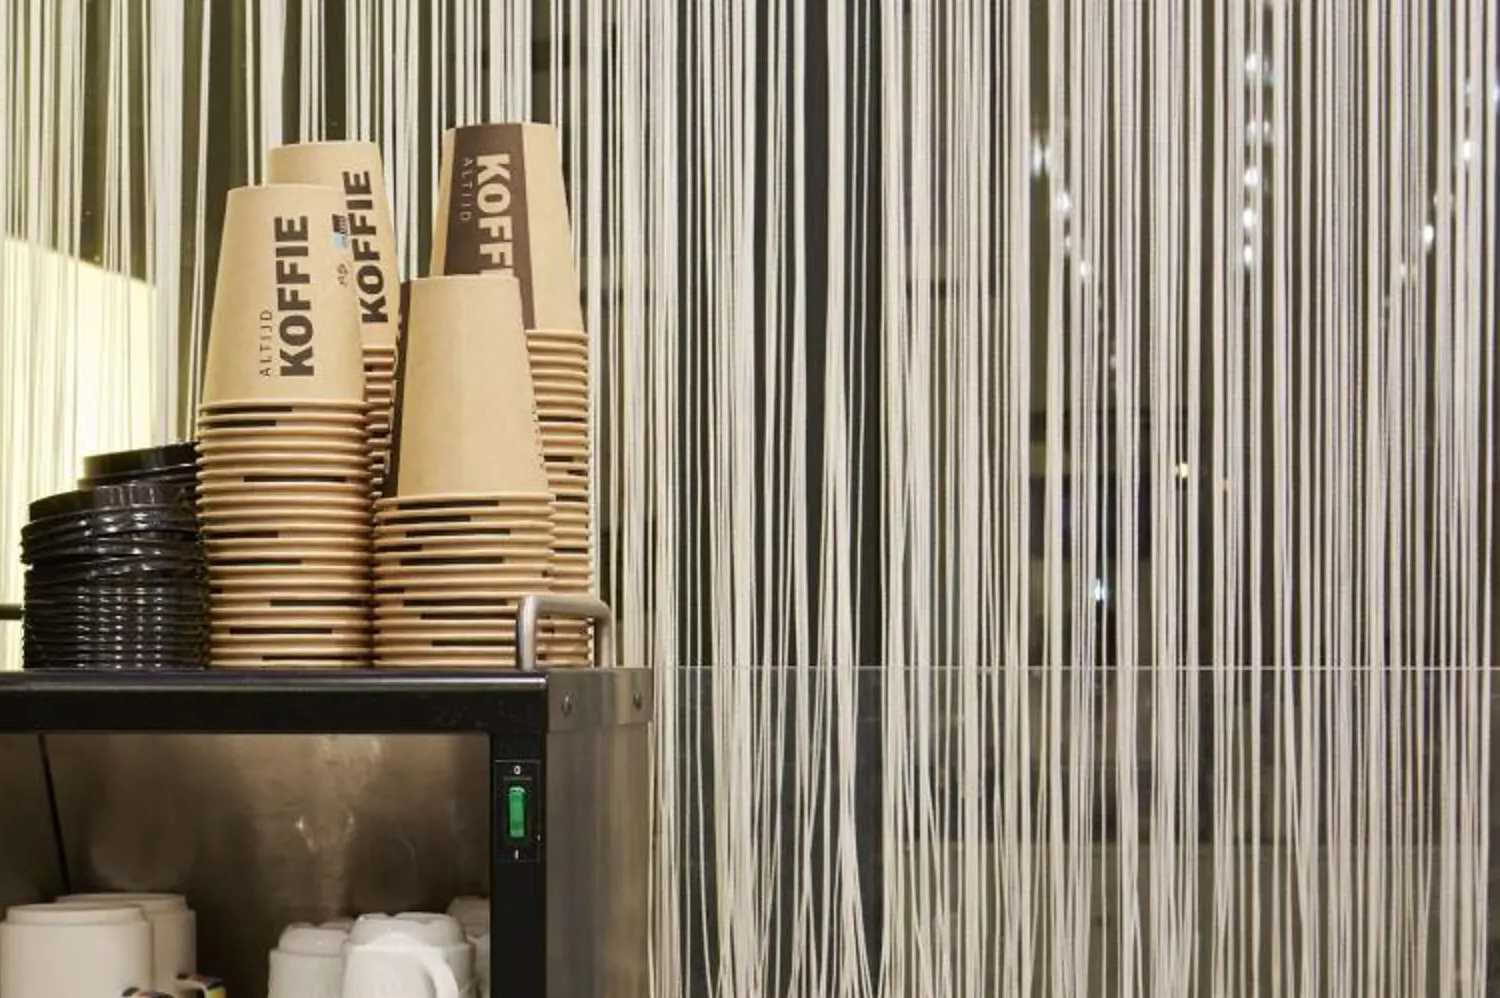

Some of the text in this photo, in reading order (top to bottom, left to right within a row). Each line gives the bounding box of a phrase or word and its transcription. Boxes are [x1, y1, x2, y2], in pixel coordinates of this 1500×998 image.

[274, 216, 315, 376] KOFFIE
[343, 171, 389, 323] KOFFIE
[260, 309, 272, 377] ALTIJD
